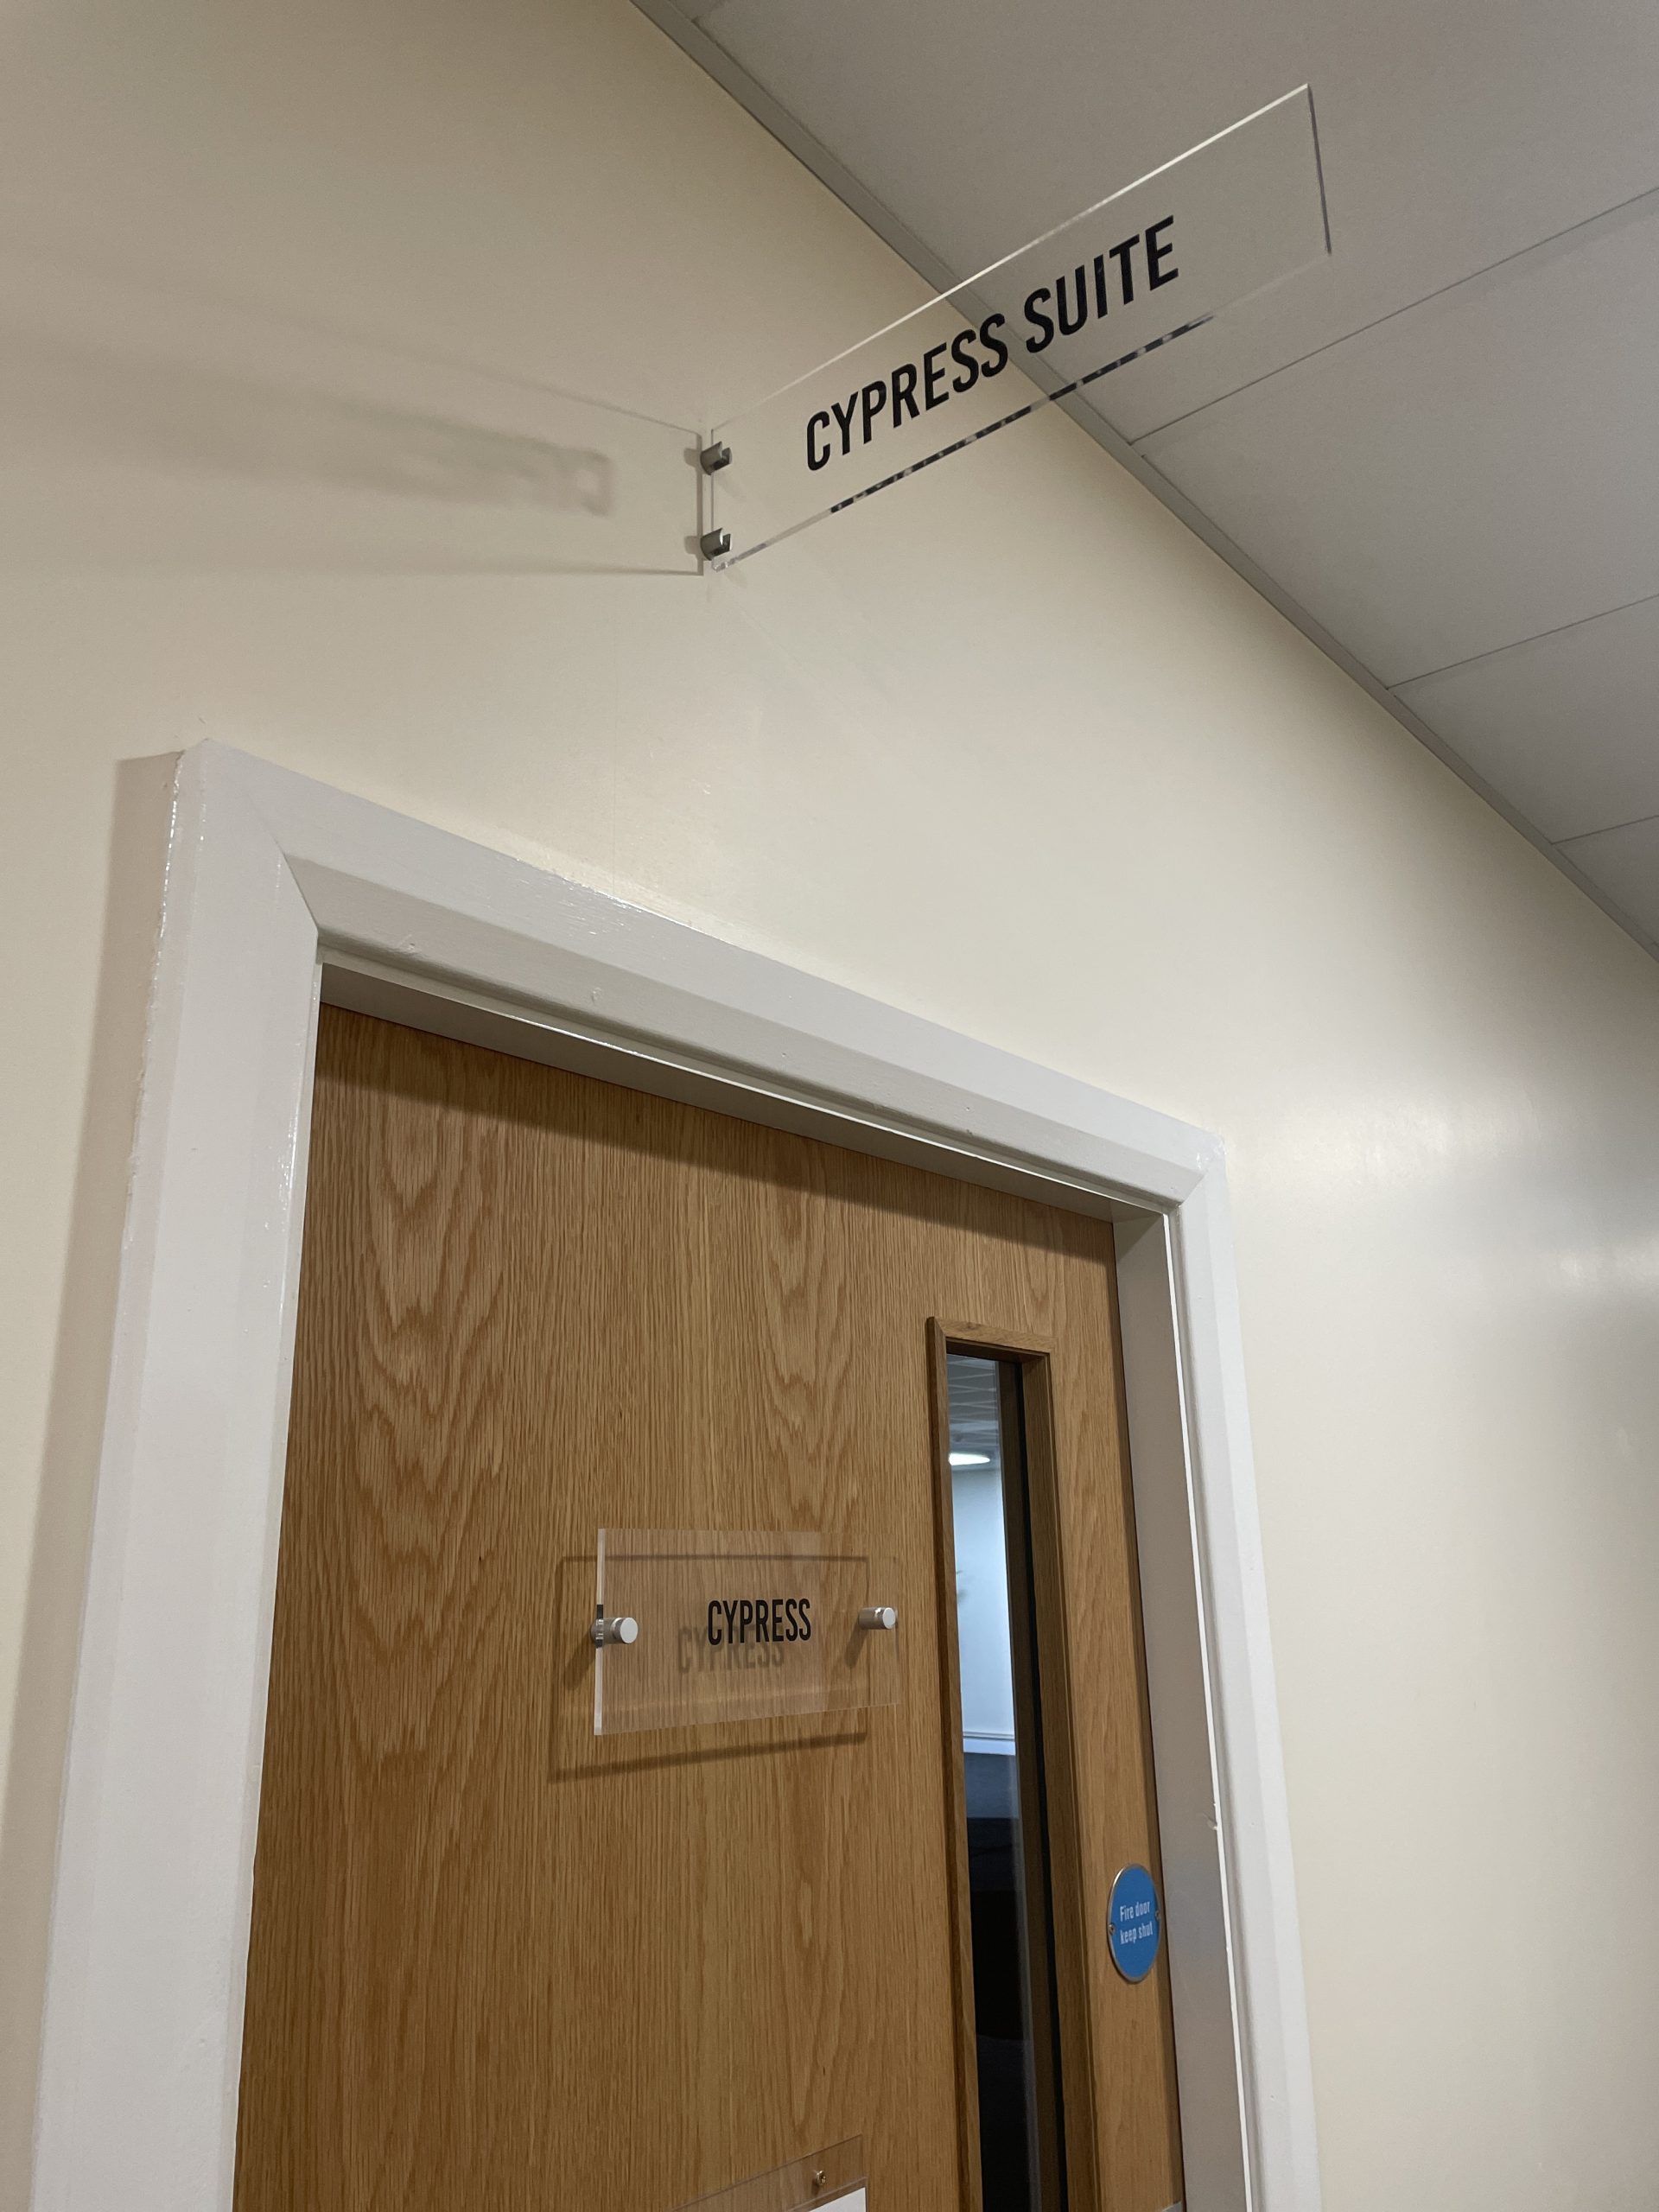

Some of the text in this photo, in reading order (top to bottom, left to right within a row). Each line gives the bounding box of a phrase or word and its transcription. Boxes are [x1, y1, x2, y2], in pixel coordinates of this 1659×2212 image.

[806, 214, 1179, 471] CYPRESS SUITE
[707, 1598, 811, 1646] CYPRESS
[1119, 1901, 1150, 1923] Fire door
[1120, 1921, 1154, 1944] keep shut
